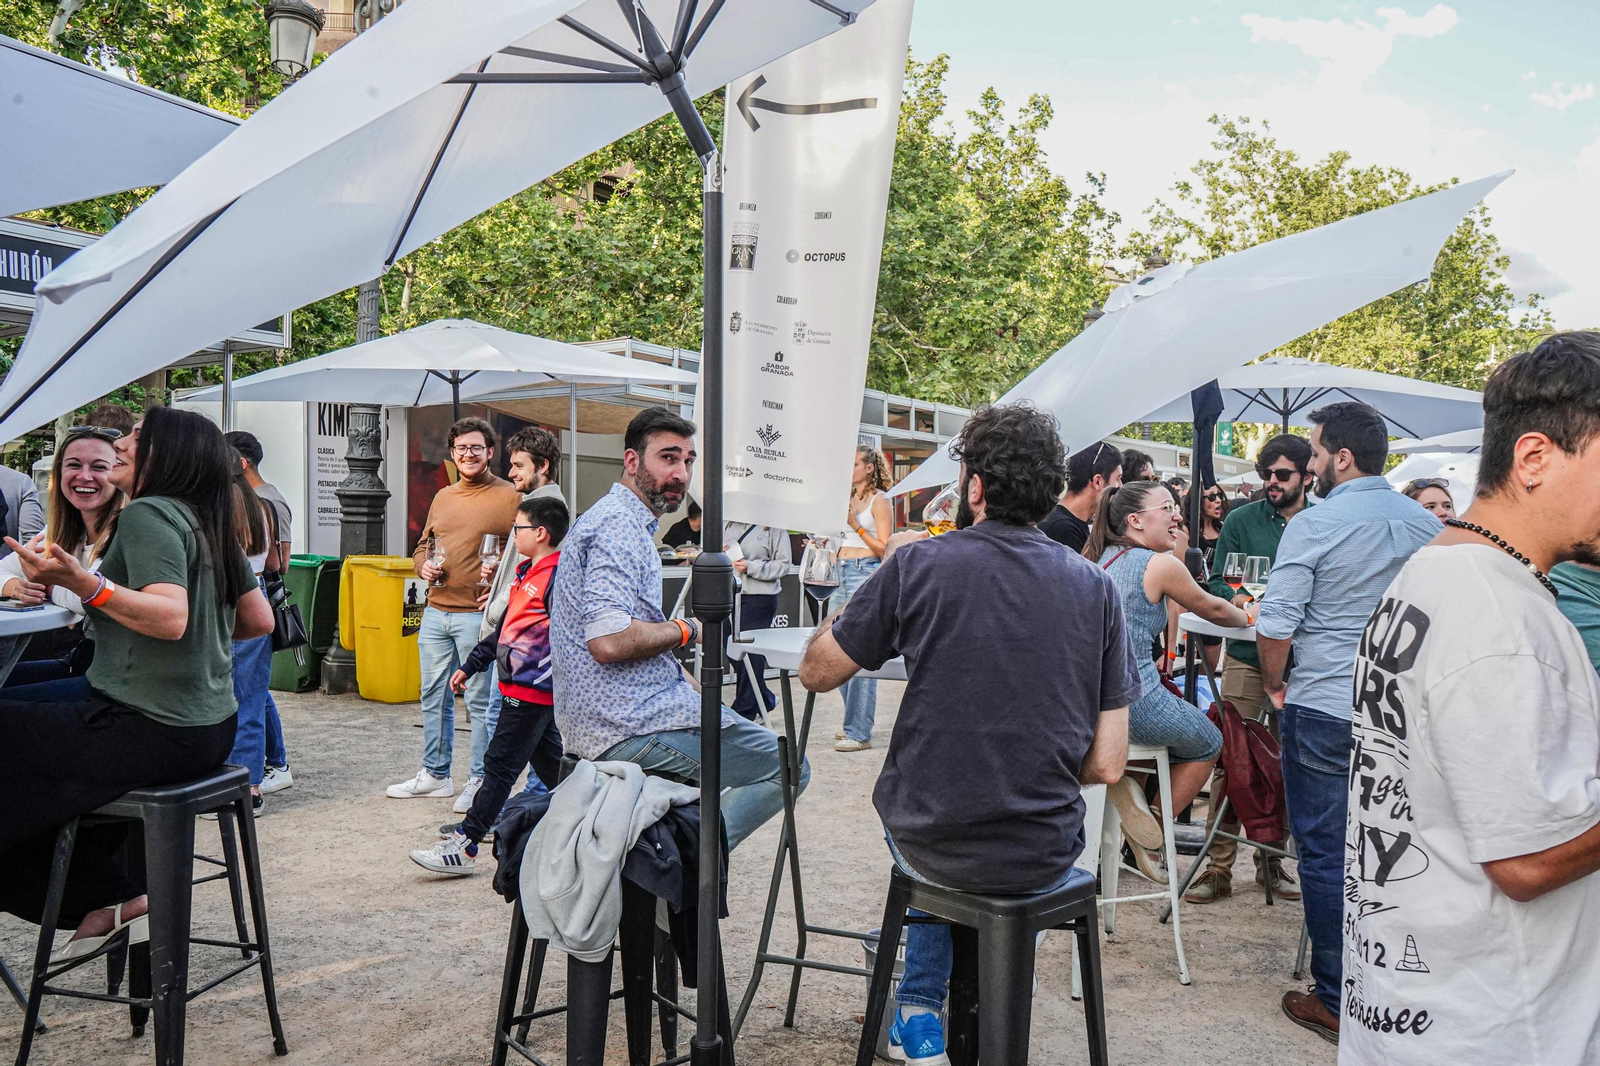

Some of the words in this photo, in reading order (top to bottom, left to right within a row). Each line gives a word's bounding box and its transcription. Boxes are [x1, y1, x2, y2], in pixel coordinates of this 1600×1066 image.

[804, 252, 846, 262] OCTOPUS
[766, 362, 790, 371] SABOR
[760, 366, 794, 377] GRANADA
[754, 453, 777, 461] GRANADA
[763, 449, 787, 458] RURAL
[402, 617, 422, 626] REC
[770, 614, 789, 628] KES
